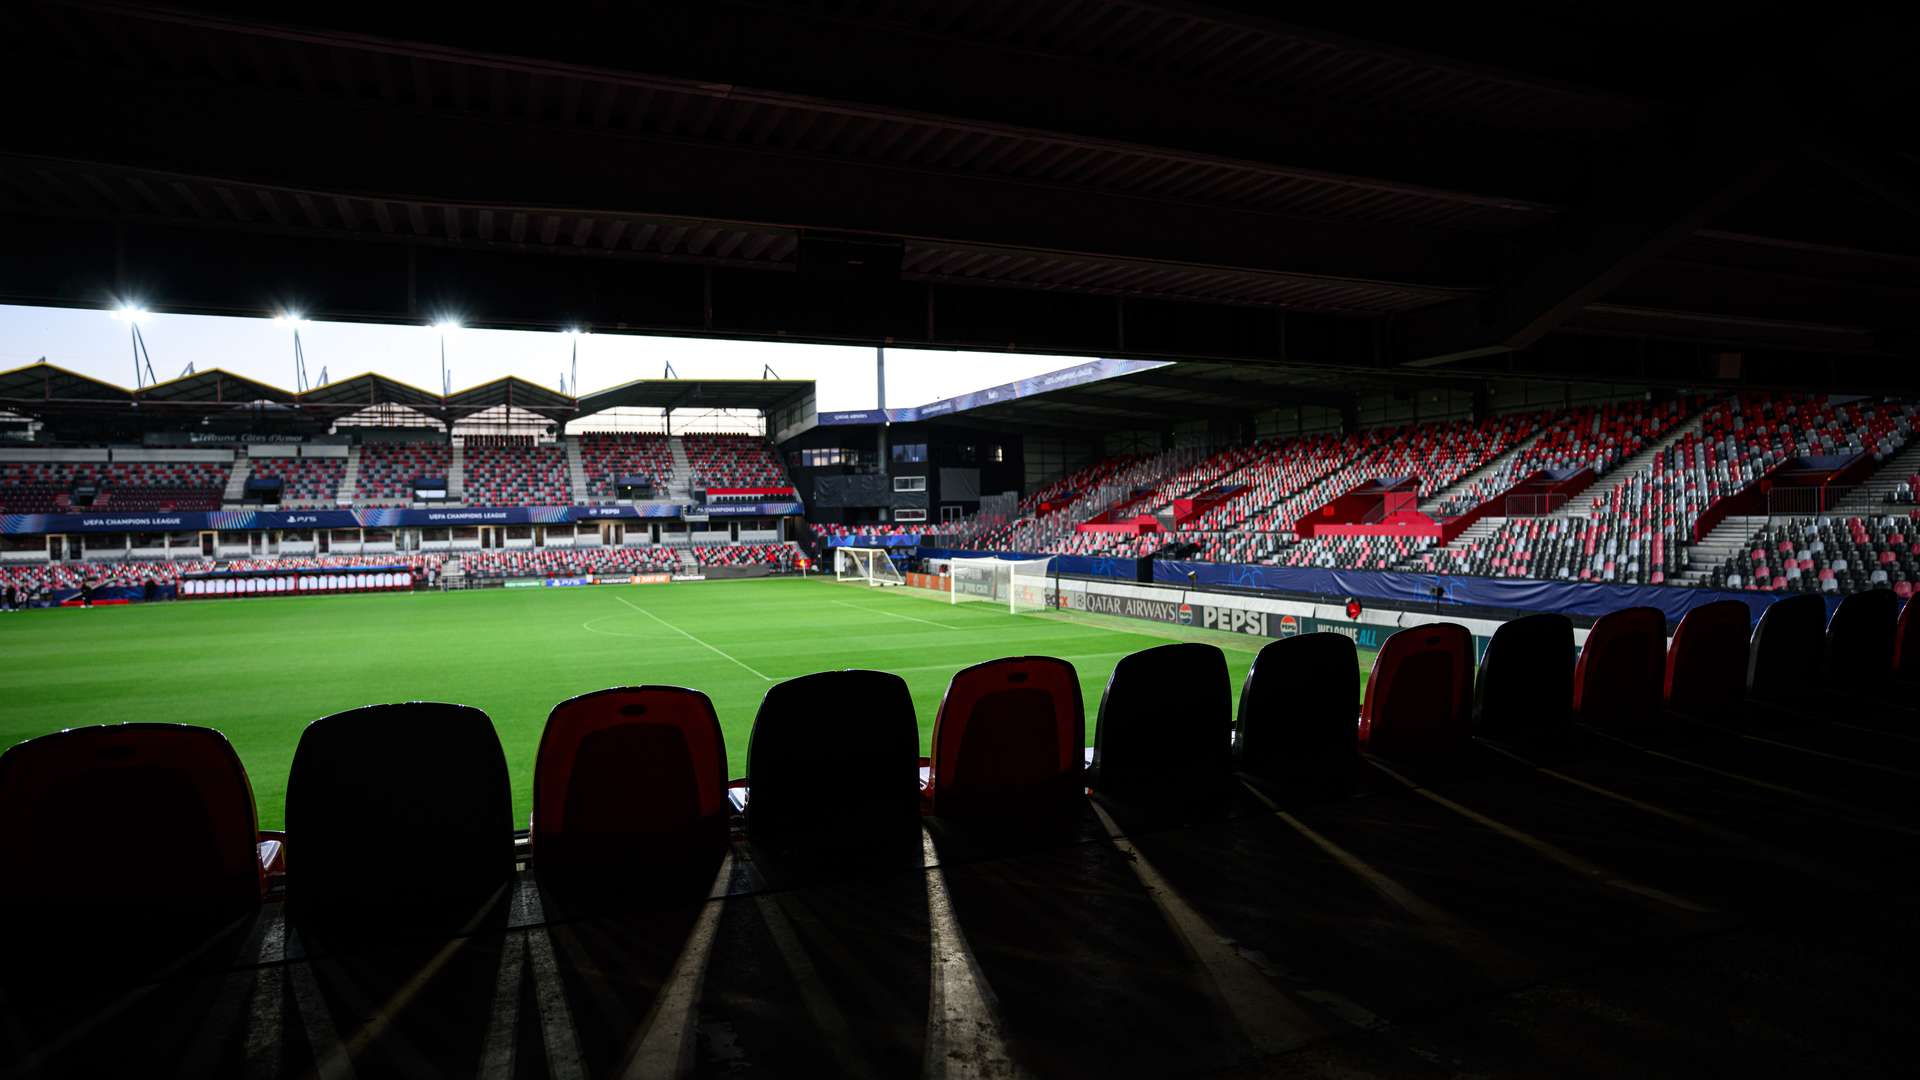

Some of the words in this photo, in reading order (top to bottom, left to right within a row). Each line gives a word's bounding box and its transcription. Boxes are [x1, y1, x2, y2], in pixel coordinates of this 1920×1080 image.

[1086, 595, 1121, 613] QATAR
[1125, 599, 1177, 621] AIRWAYS
[1203, 606, 1268, 636] PEPSI
[1359, 629, 1377, 647] ALL
